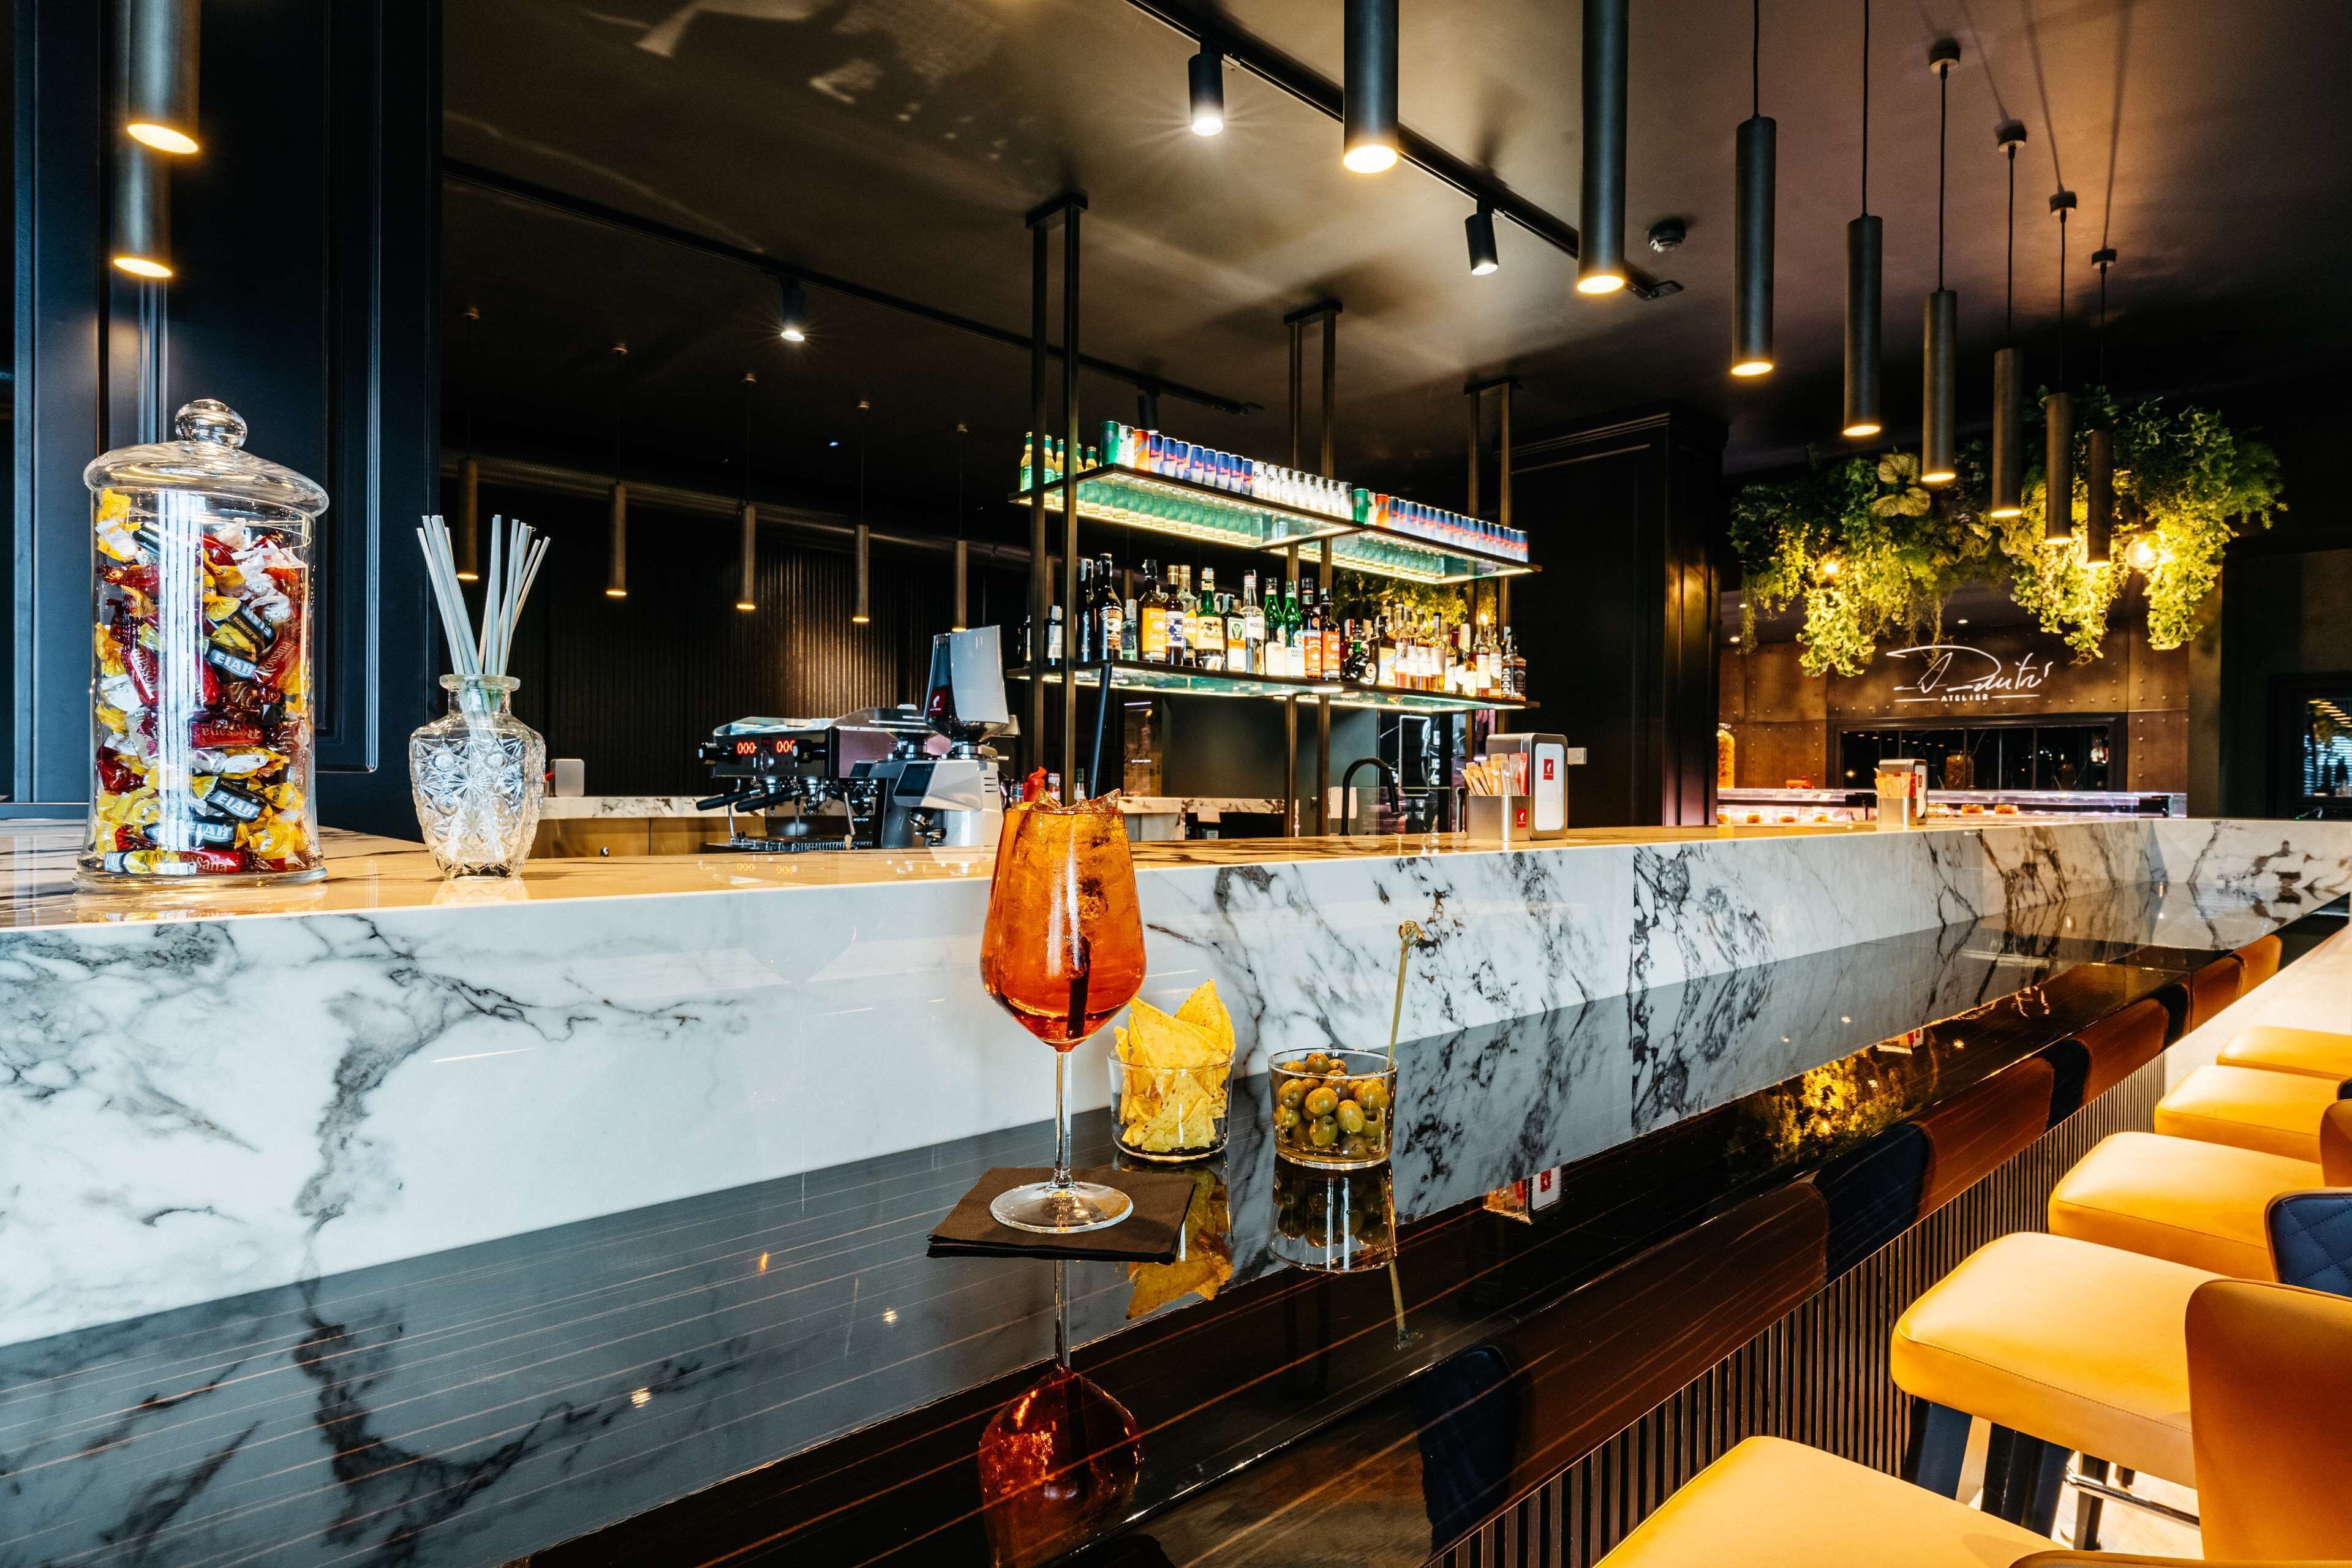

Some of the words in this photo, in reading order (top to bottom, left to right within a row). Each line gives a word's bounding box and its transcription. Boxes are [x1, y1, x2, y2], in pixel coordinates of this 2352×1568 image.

[214, 650, 255, 676] ELAH
[255, 641, 292, 677] Rossana
[1940, 693, 1989, 702] ATELIER
[215, 793, 255, 816] ELAH
[179, 853, 228, 873] ossana
